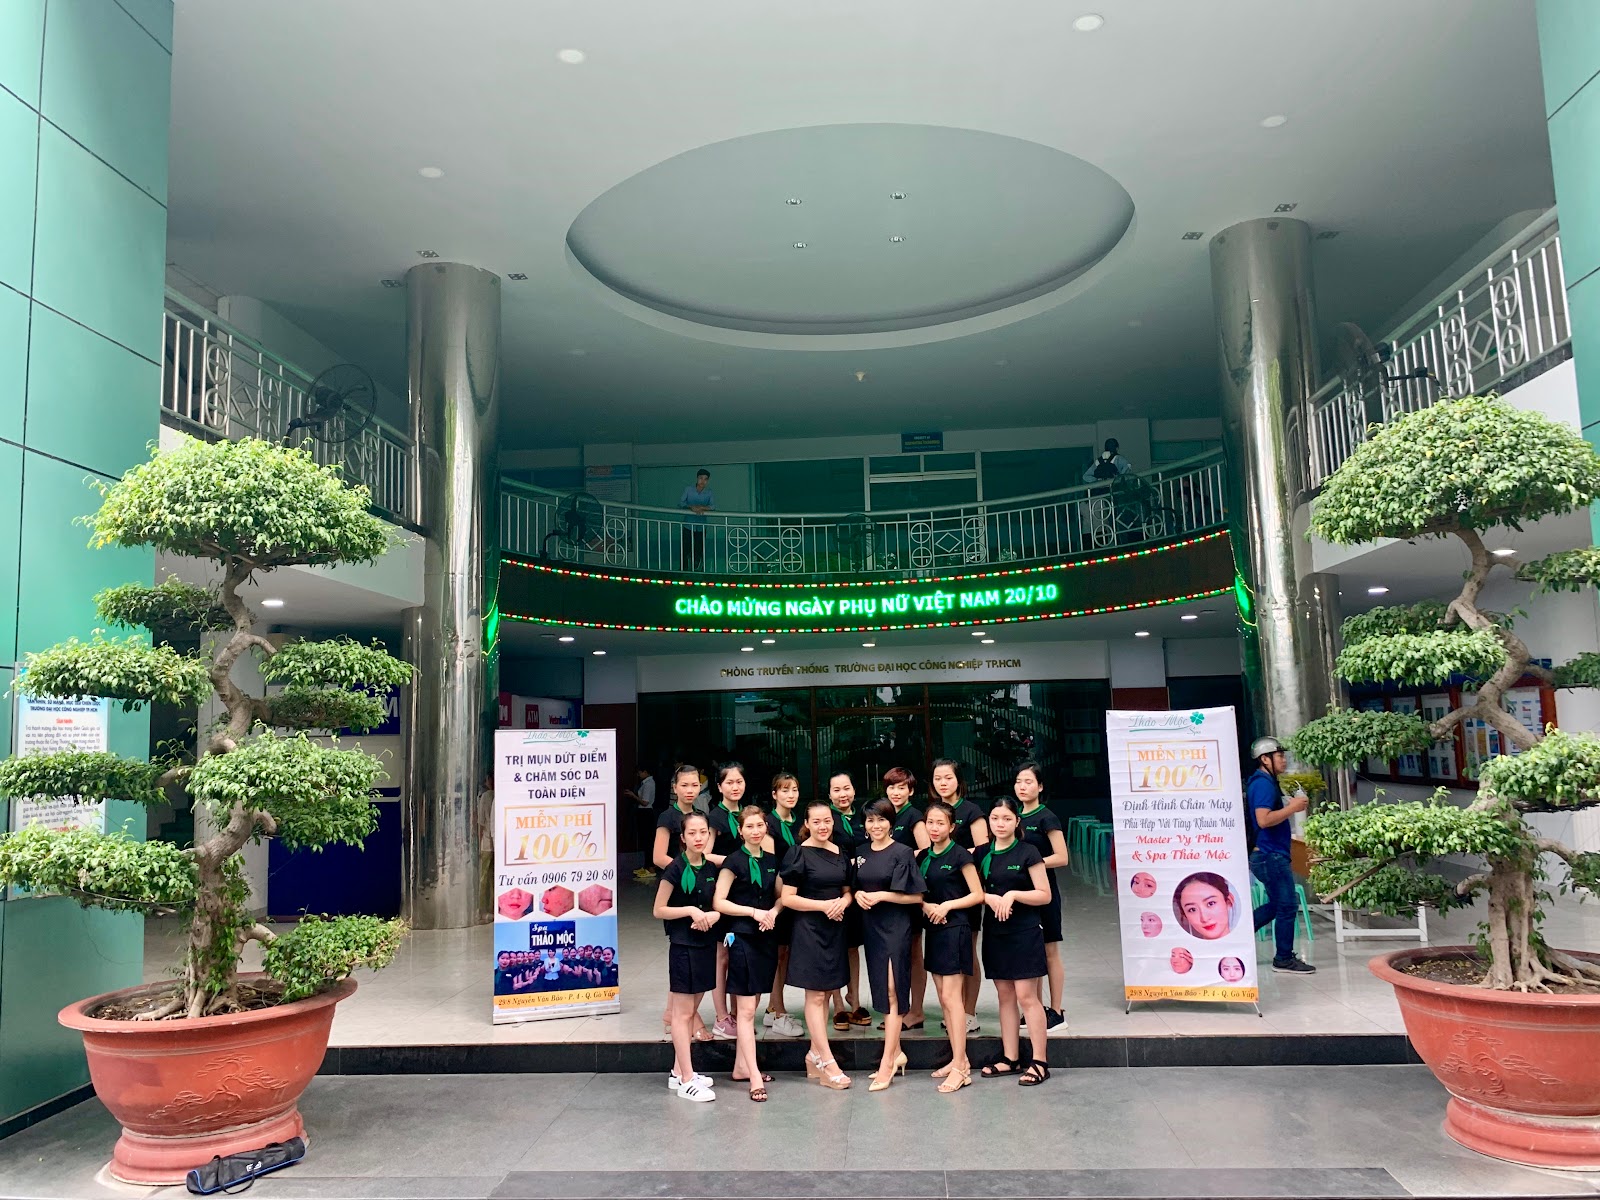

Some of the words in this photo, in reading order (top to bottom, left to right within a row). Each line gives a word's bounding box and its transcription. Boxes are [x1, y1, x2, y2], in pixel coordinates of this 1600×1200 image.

[675, 594, 723, 615] CHÀO
[727, 596, 781, 616] MỪNG
[785, 596, 835, 616] NGÀY
[839, 598, 876, 618] PHỤ
[881, 593, 910, 613] NỮ
[913, 590, 956, 614] VIỆT
[960, 590, 999, 608] NAM
[1004, 584, 1057, 605] 20/10
[720, 667, 754, 677] PHÒNG
[796, 662, 829, 675] THỐNG
[835, 662, 876, 673] TRƯỜNG
[877, 662, 894, 674] ĐẠI
[896, 661, 917, 673] HỌC
[918, 659, 947, 670] CÔNG
[948, 658, 983, 671] NGHIỆP
[985, 658, 1021, 669] TP.HCM
[1128, 714, 1156, 728] Thảo
[1159, 713, 1188, 726] Mộc
[505, 755, 524, 767] TRỊ
[527, 754, 552, 766] MỤN
[555, 751, 576, 764] DỨT
[580, 748, 607, 763] ĐIỂM
[1137, 744, 1176, 762] MIỄN
[1180, 745, 1207, 760] PHÍ
[513, 772, 522, 782] &
[525, 769, 557, 782] CHĂM
[560, 768, 581, 781] SÓC
[585, 769, 600, 780] DA
[1138, 763, 1214, 788] 100%
[528, 786, 557, 799] TOÀN
[560, 785, 586, 799] DIỆN
[1122, 799, 1149, 813] Định
[1151, 798, 1177, 811] Hình
[1180, 797, 1205, 811] Chân
[1208, 798, 1233, 812] Mày
[515, 810, 559, 829] MIỄN
[563, 810, 593, 827] PHÍ
[1122, 817, 1138, 829] Phù
[1139, 818, 1156, 832] Hợp
[1158, 818, 1171, 829] Với
[1172, 817, 1192, 831] Từng
[1193, 816, 1218, 830] Khuôn
[1219, 817, 1235, 830] Mặt
[514, 830, 598, 861] 100%
[1136, 834, 1173, 845] Master
[1176, 834, 1192, 846] Vy
[1195, 833, 1224, 844] Phan
[1131, 850, 1143, 862] &
[1145, 849, 1168, 863] Spa
[1171, 848, 1202, 861] Thảo
[1204, 849, 1232, 862] Mộc
[498, 873, 515, 887] Tư
[517, 871, 538, 885] vấn
[541, 871, 567, 884] 0906
[571, 871, 583, 882] 79
[586, 870, 599, 882] 20
[602, 869, 614, 881] 80
[532, 923, 548, 935] Spa
[531, 931, 554, 947] THẢO
[556, 930, 575, 947] MỘC
[585, 992, 592, 1000] Q.
[1221, 990, 1229, 998] Q.
[1242, 989, 1255, 999] Vấp
